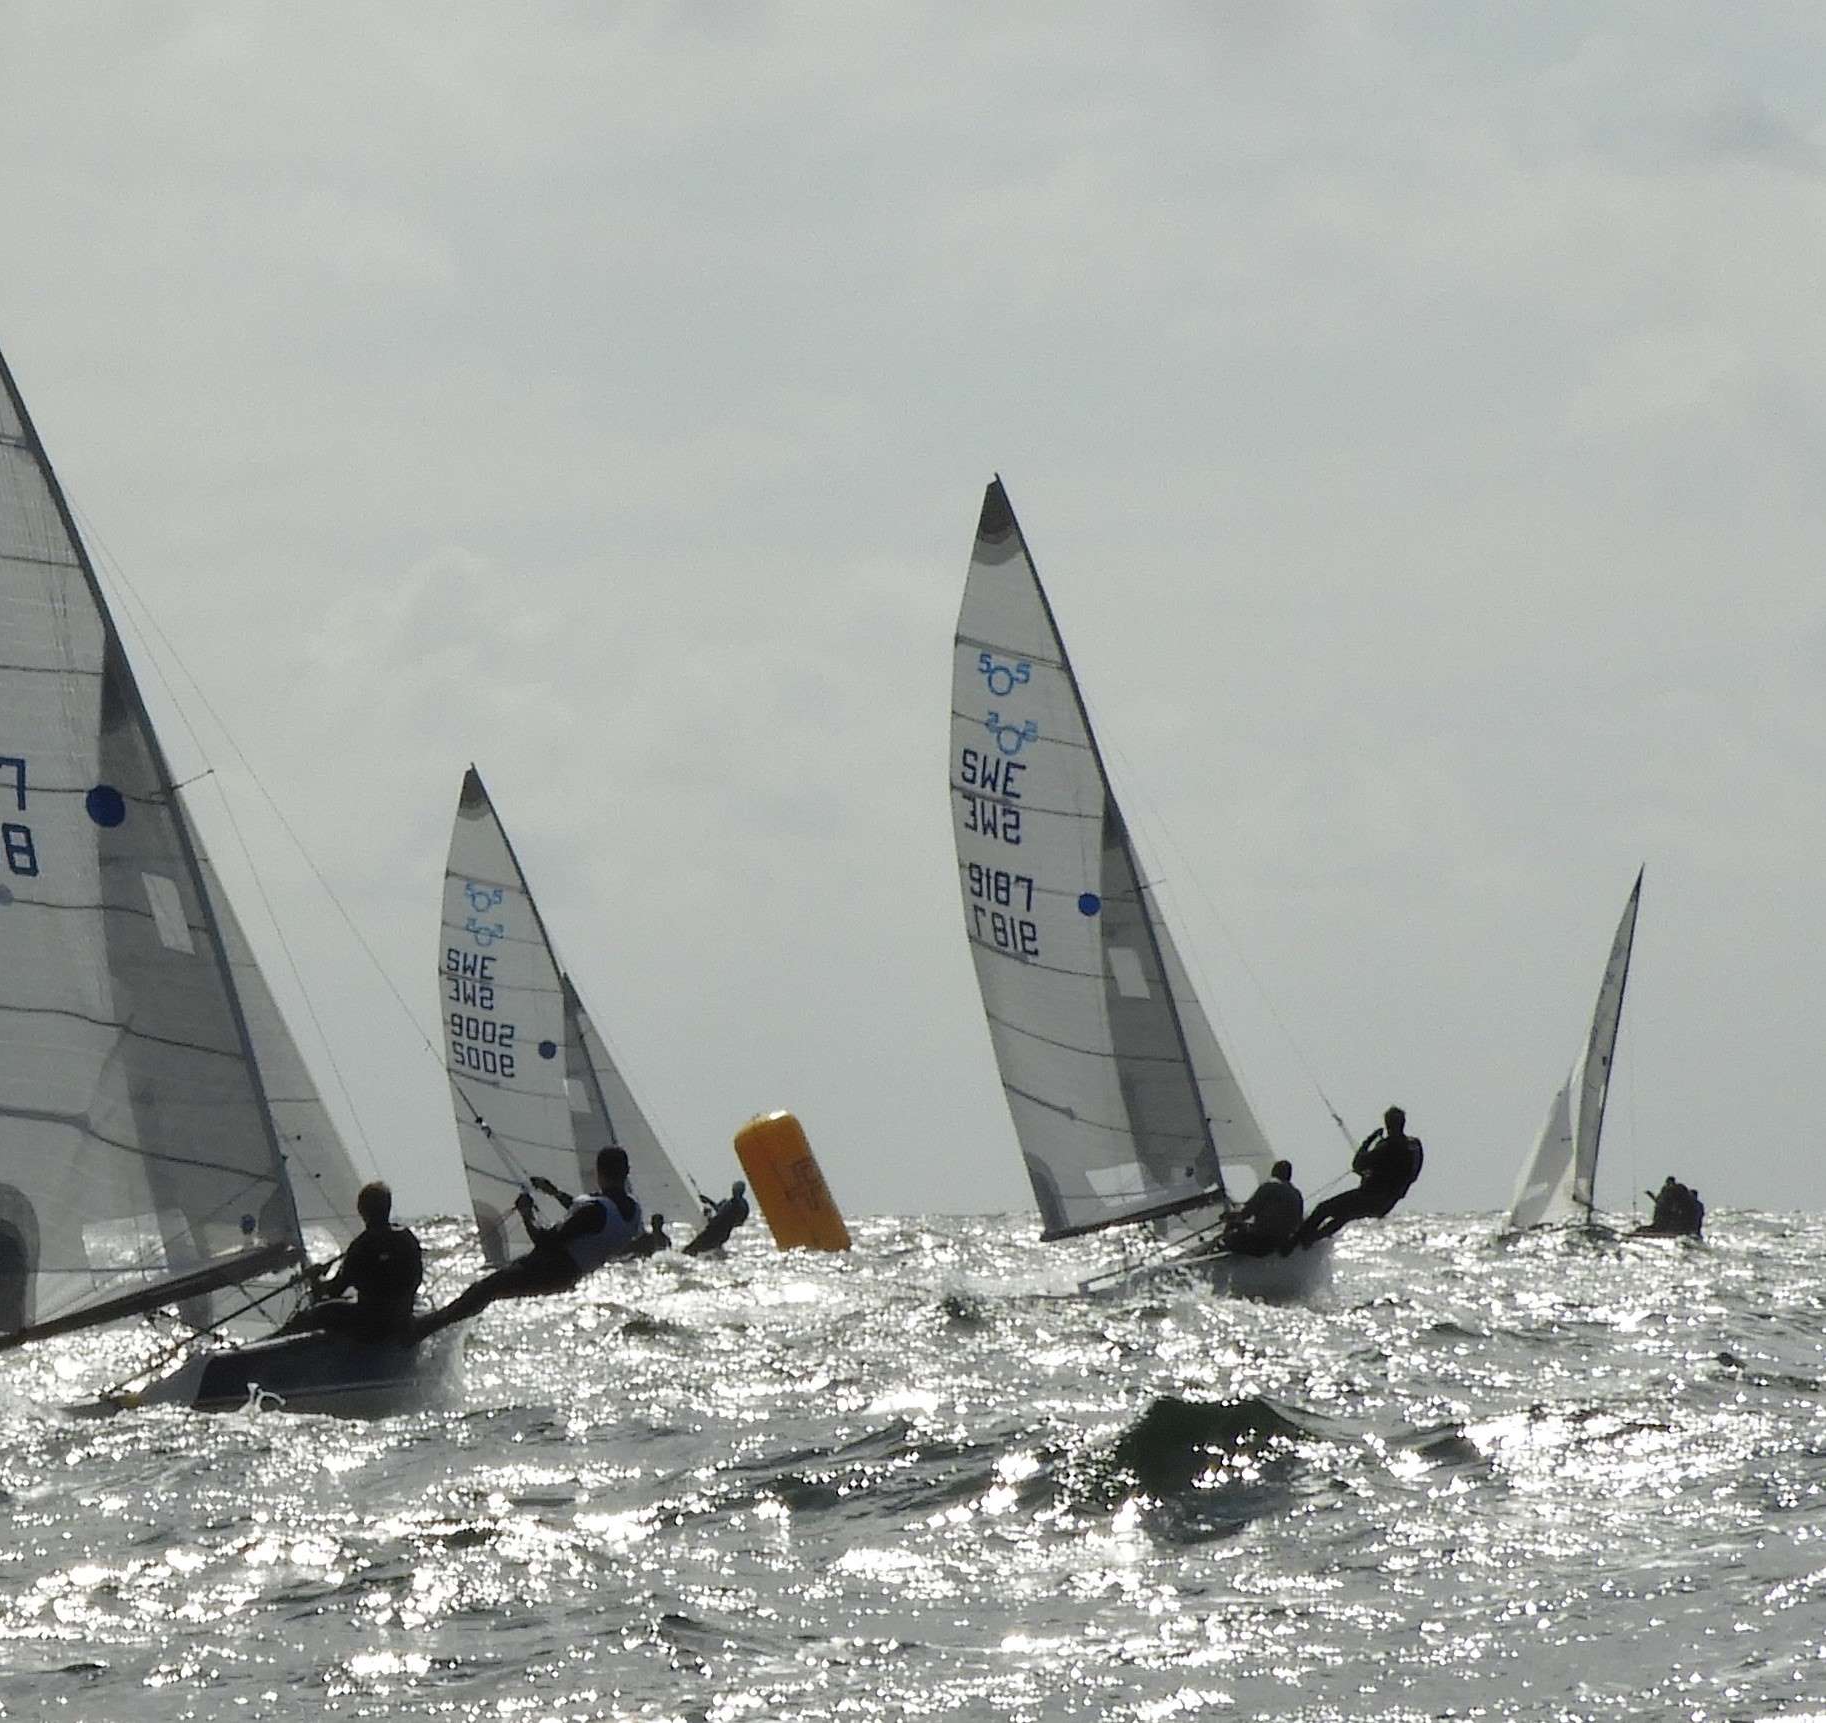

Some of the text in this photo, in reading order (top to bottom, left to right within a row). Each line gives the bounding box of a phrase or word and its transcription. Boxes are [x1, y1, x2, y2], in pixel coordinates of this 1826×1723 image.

[961, 747, 1027, 799] SWE
[969, 862, 1034, 913] 9187
[446, 947, 498, 981] SWE
[450, 1012, 515, 1049] 9002
